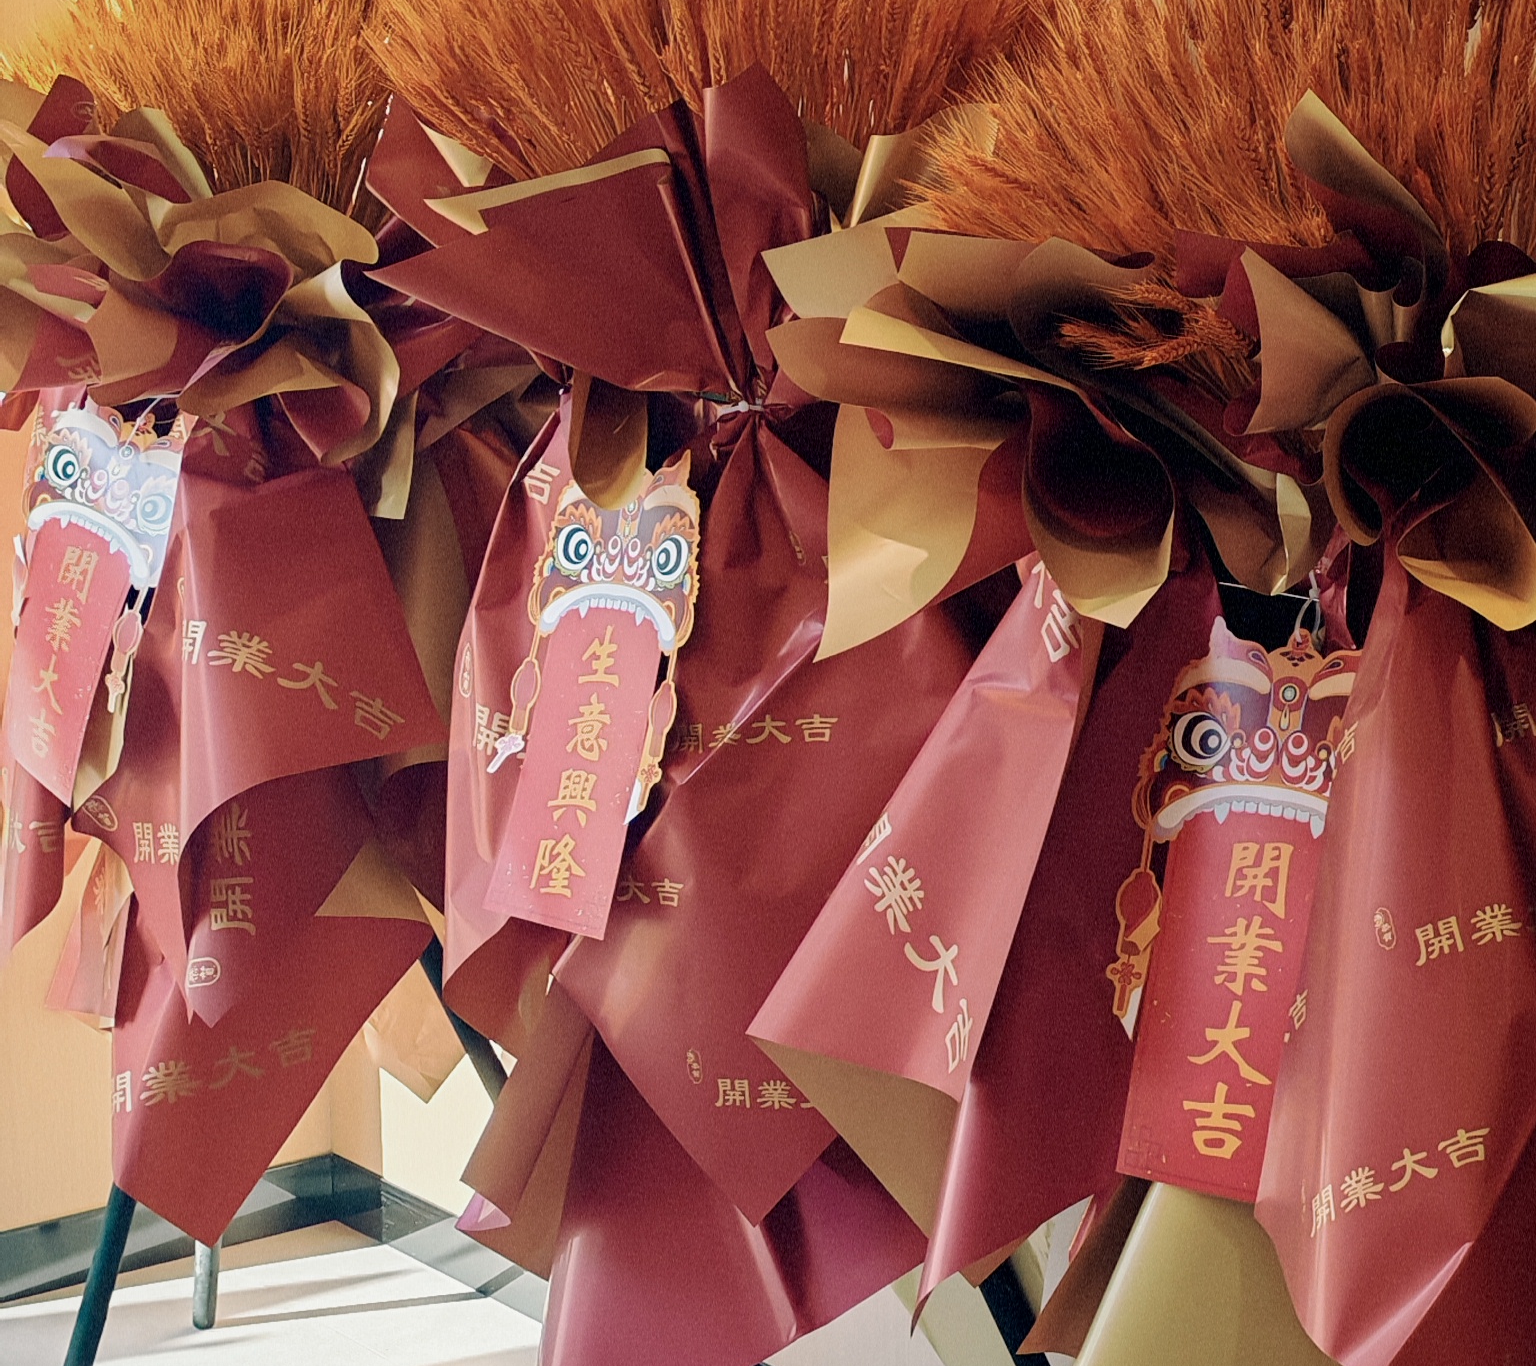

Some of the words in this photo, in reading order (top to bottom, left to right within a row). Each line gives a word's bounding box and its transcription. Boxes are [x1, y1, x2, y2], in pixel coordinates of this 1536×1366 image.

[28, 544, 99, 759] 開業大吉
[530, 625, 623, 899] 生意興隆
[714, 1078, 814, 1111] 開業
[1182, 841, 1295, 1160] 開業大吉
[1308, 1126, 1492, 1238] 開業大吉
